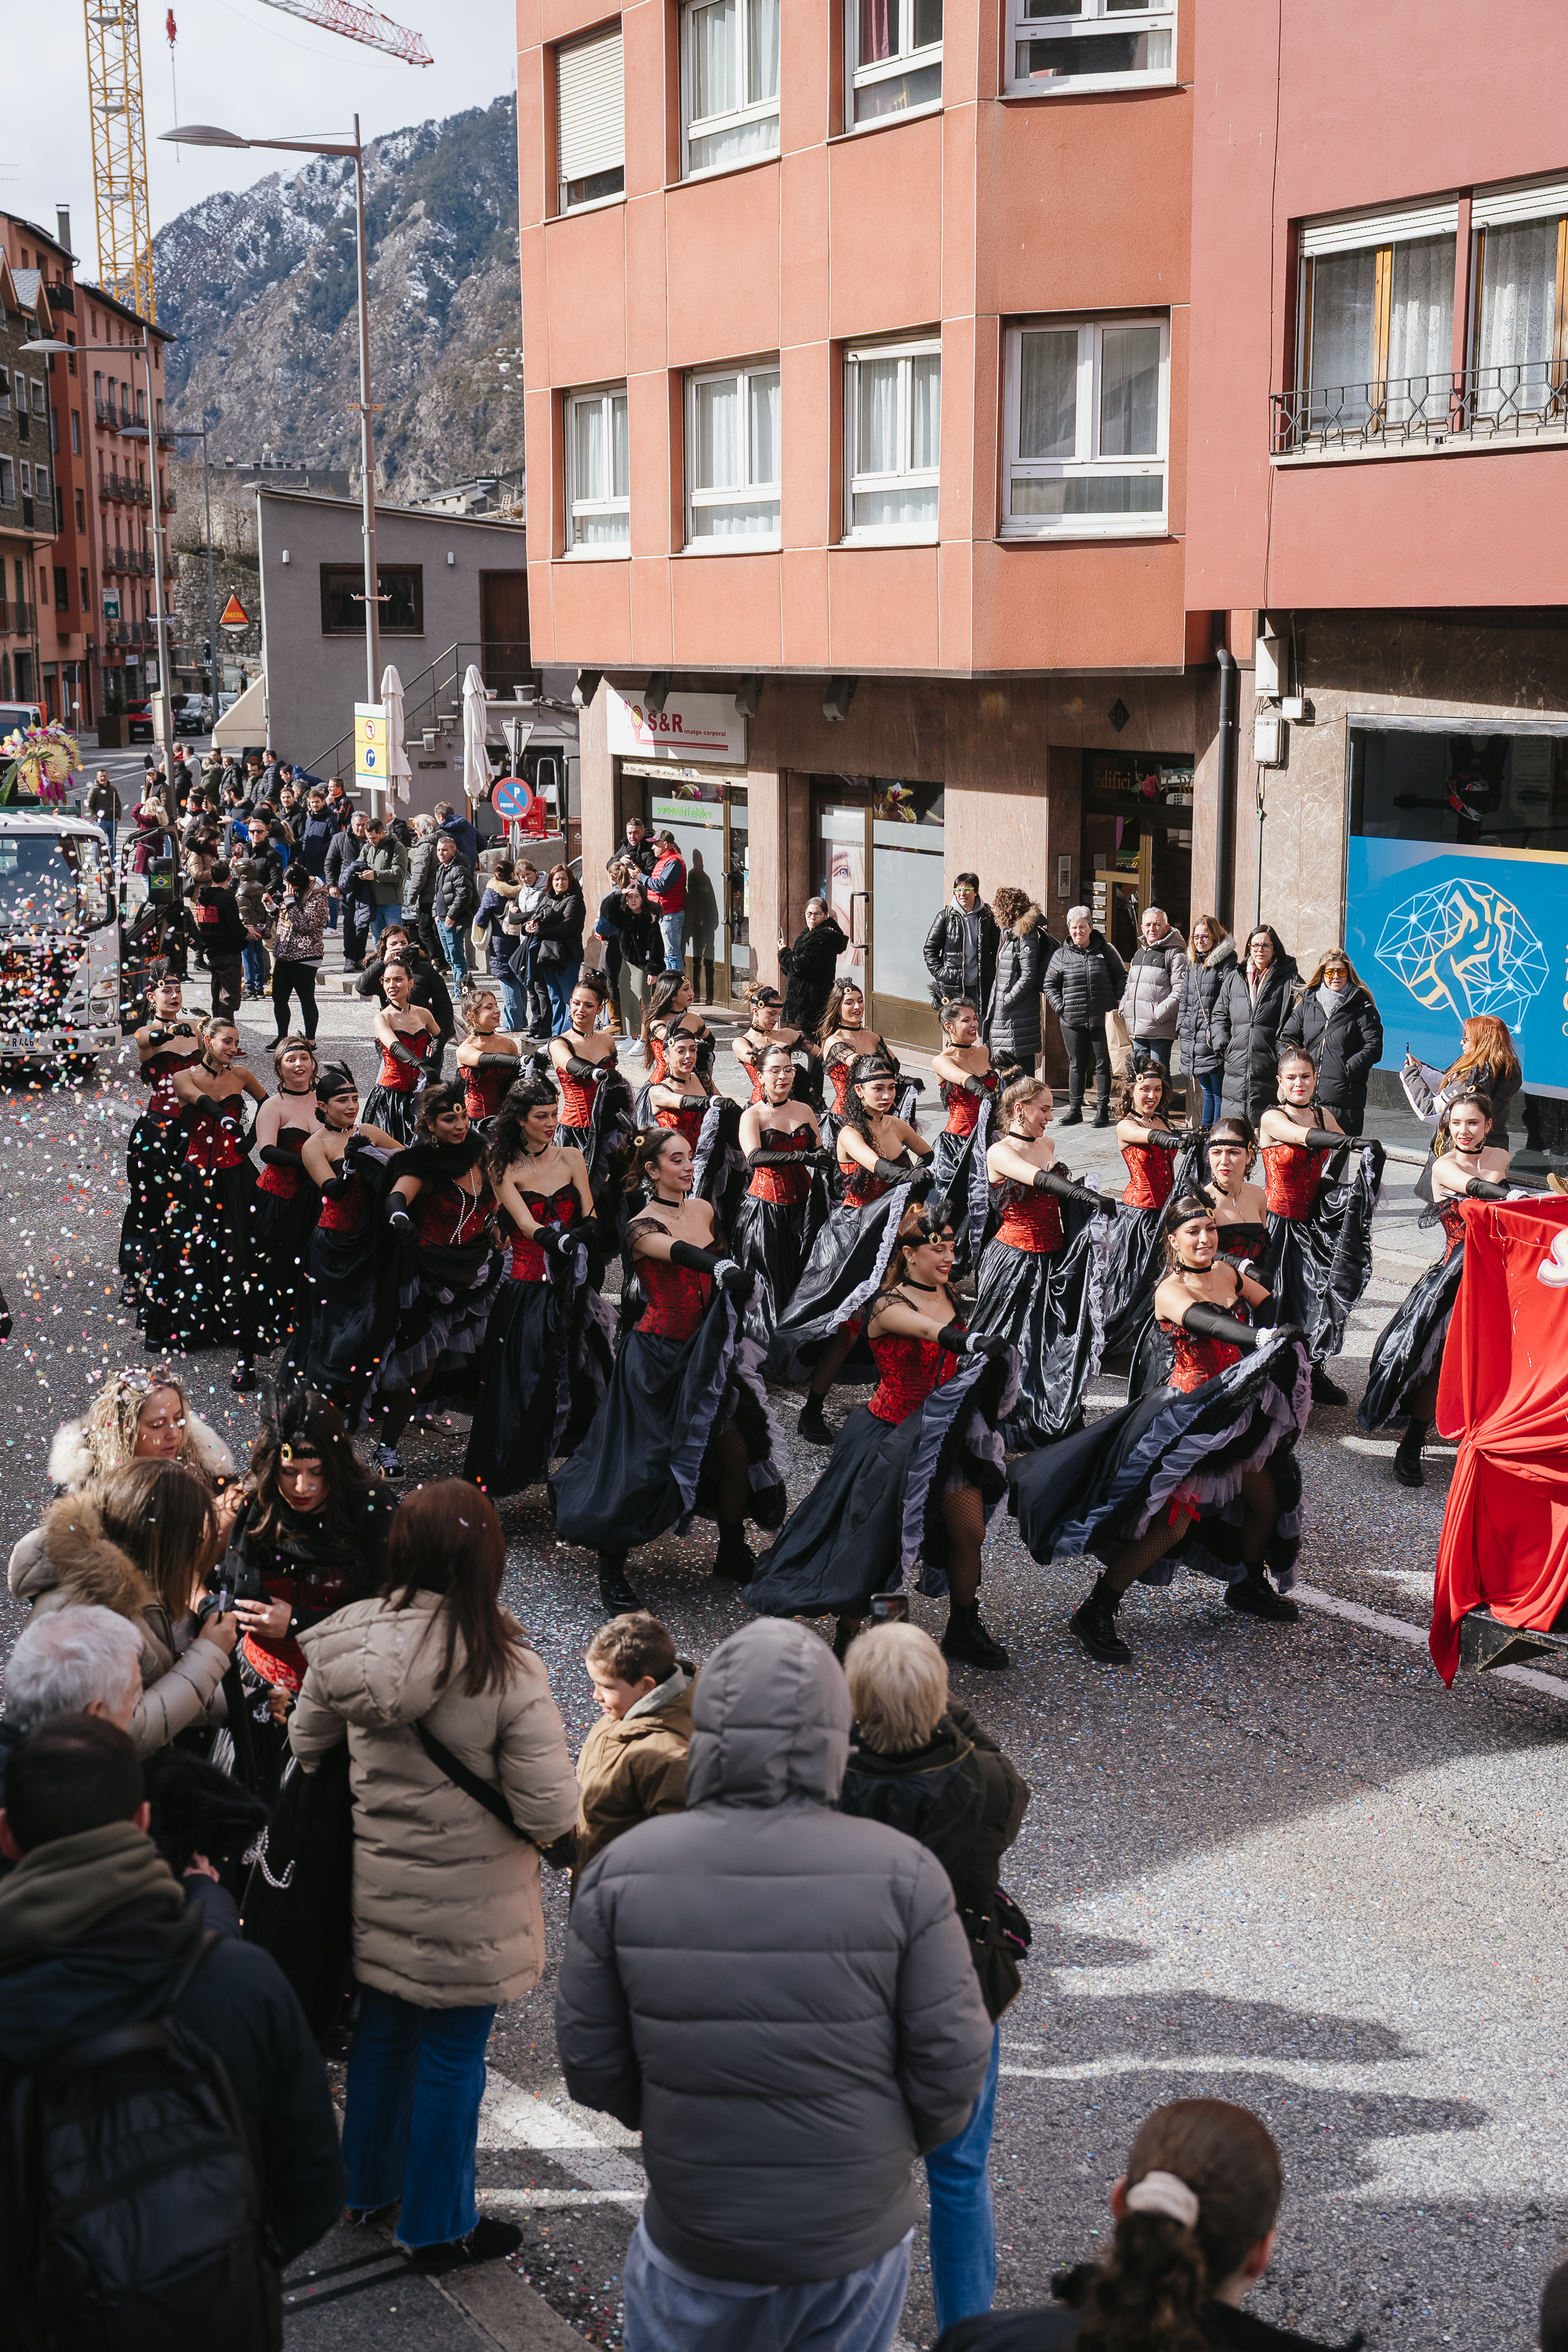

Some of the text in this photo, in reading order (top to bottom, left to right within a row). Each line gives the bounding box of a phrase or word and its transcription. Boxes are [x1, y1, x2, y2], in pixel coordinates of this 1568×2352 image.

[648, 711, 683, 733] S&R
[1109, 707, 1123, 723] 40
[1094, 769, 1131, 790] Edifici
[1137, 773, 1172, 793] SANT
[514, 786, 521, 798] P
